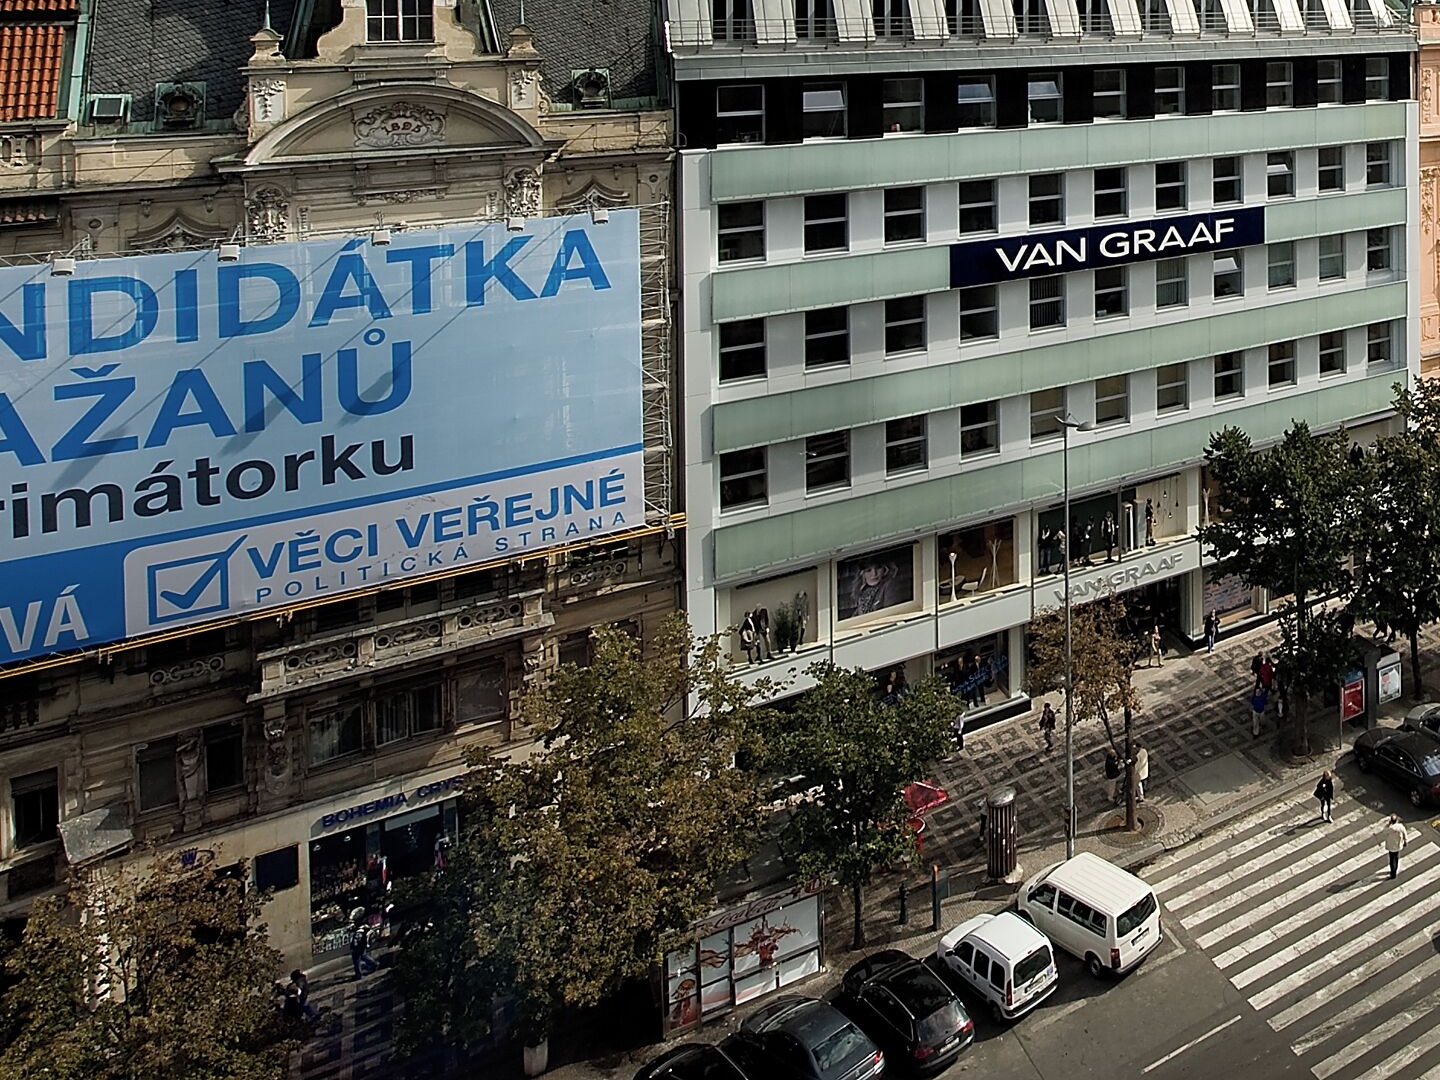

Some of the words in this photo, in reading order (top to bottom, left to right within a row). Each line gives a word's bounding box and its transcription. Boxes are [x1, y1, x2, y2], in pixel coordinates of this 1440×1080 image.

[995, 237, 1086, 272] VAN
[1099, 218, 1235, 258] GRAAF
[0, 434, 415, 538] imátorku
[247, 528, 379, 579] VĚCI
[396, 468, 626, 549] VEŘEJNÉ
[256, 541, 468, 603] POLITICKÁ
[495, 512, 626, 552] STRANA
[1107, 553, 1183, 587] GRAAF
[0, 583, 89, 653] VÁ
[322, 792, 407, 827] BOHEMIA
